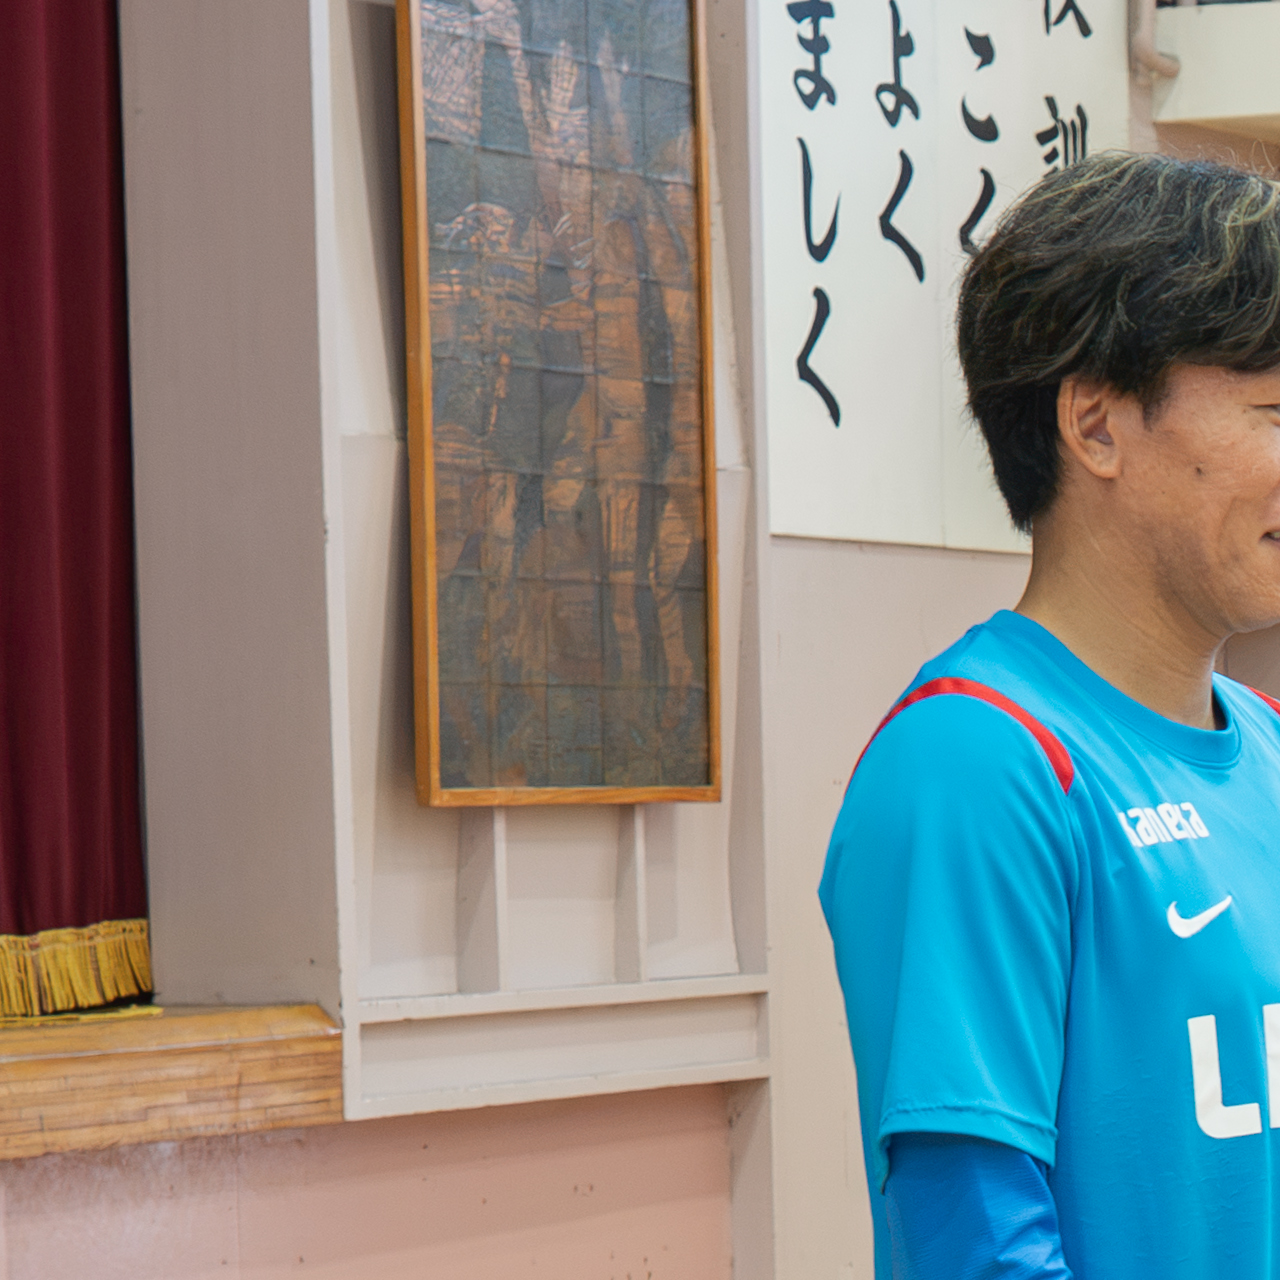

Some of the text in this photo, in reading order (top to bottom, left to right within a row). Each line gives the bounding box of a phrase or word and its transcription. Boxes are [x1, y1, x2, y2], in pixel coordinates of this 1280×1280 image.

[786, 0, 842, 429] ましく
[875, 0, 925, 284] よく
